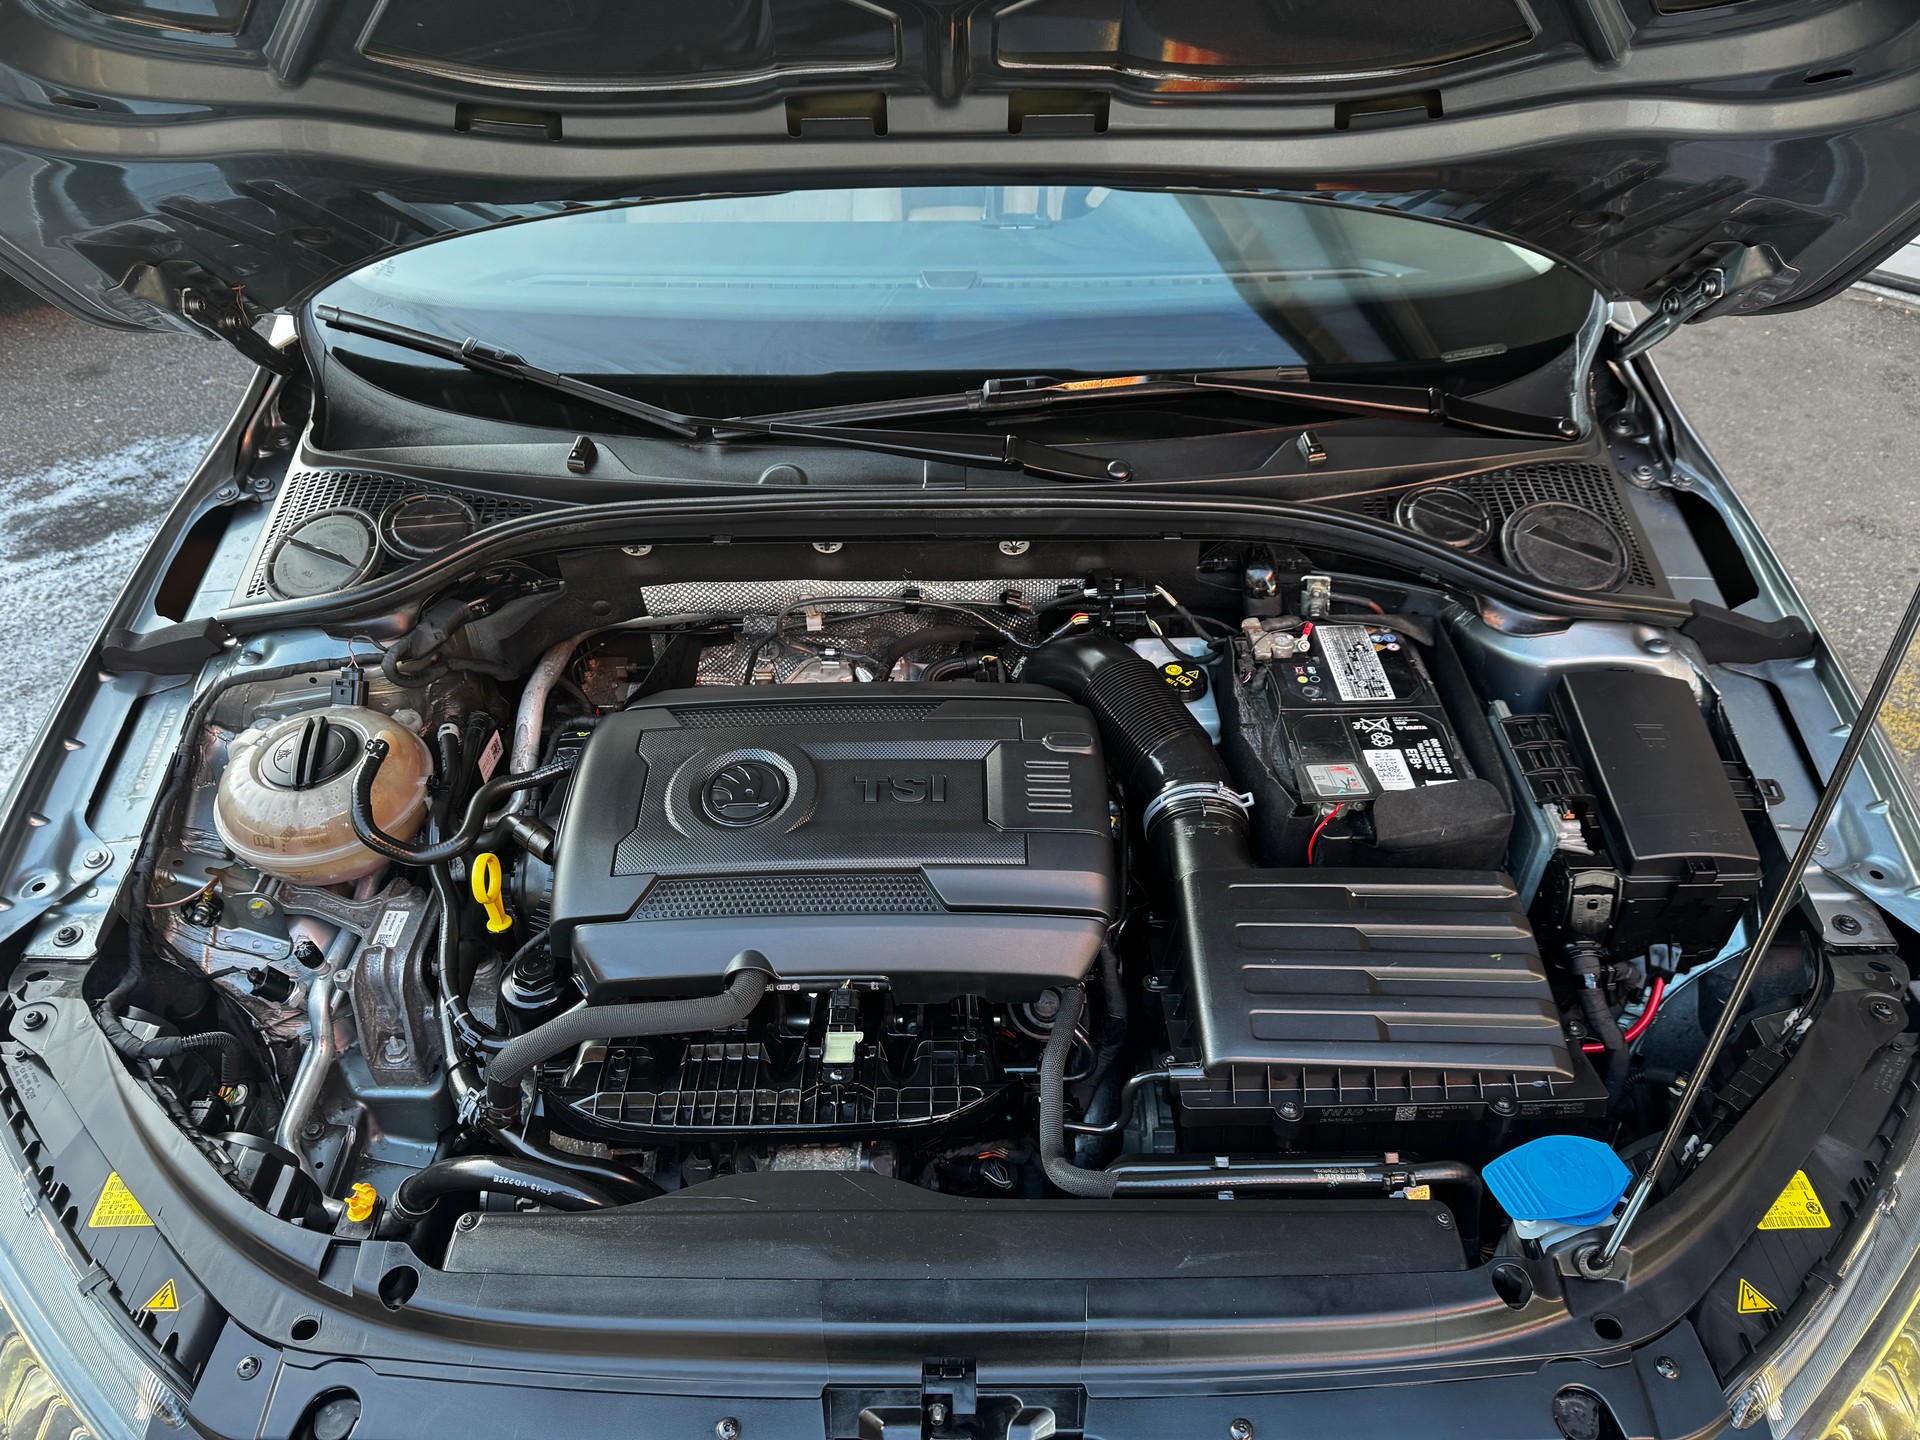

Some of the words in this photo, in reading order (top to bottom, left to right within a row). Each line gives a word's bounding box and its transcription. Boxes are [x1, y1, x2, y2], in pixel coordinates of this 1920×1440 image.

[1405, 748, 1423, 770] EFB+
[854, 774, 947, 803] TSI
[1321, 1108, 1343, 1117] VW
[1803, 1191, 1814, 1201] L
